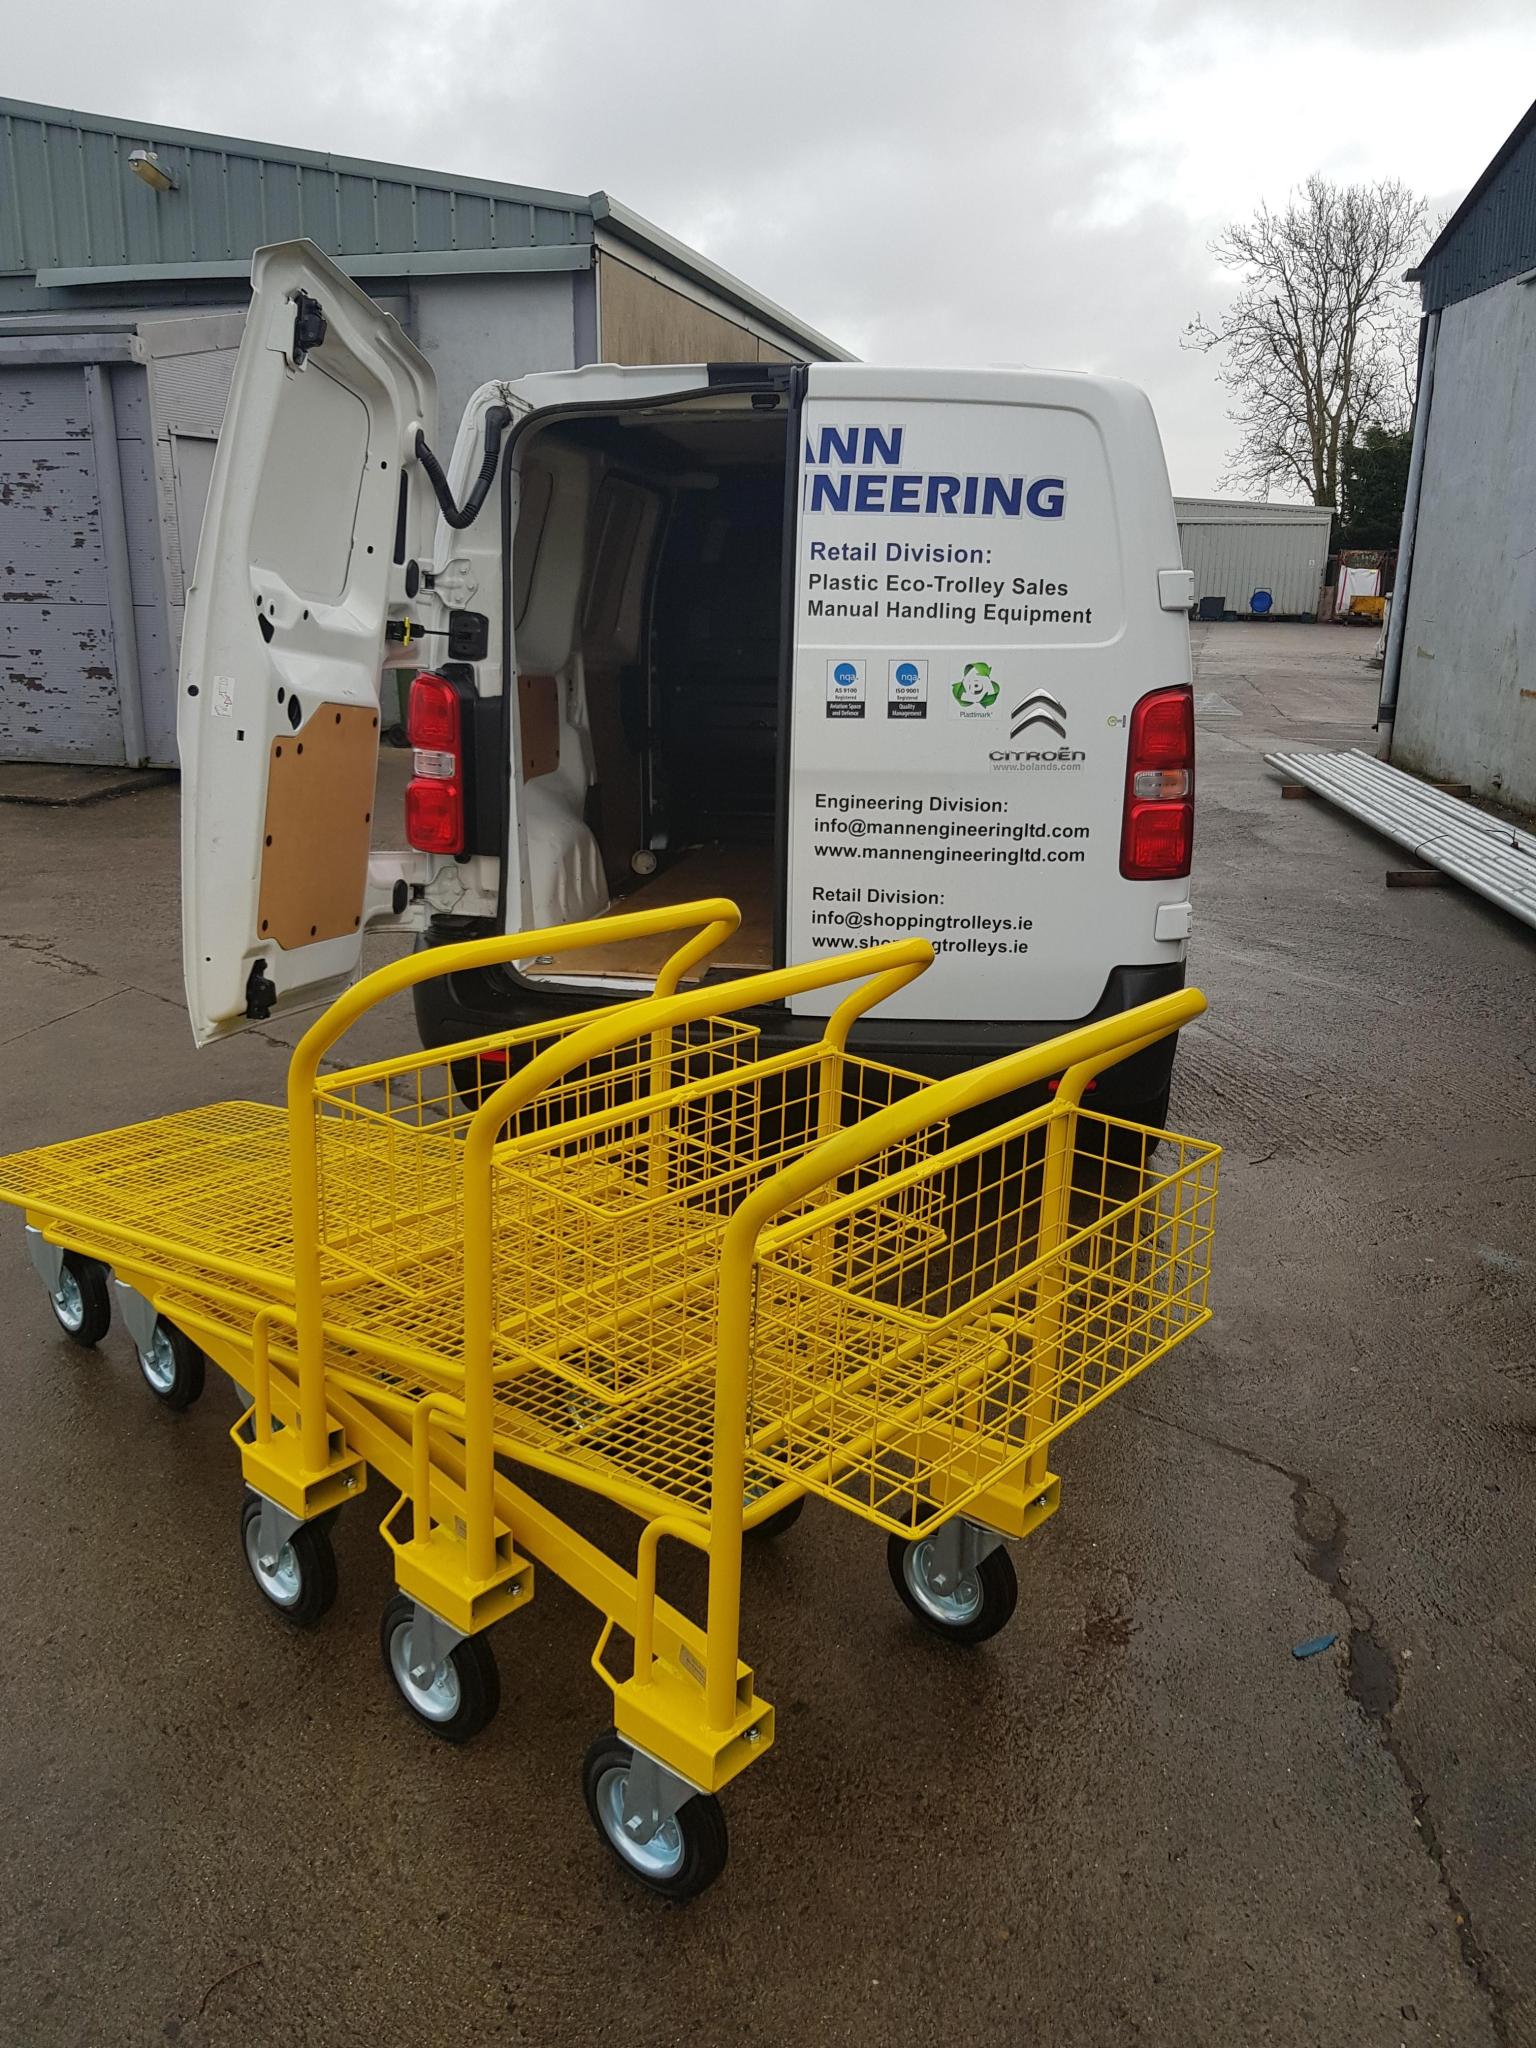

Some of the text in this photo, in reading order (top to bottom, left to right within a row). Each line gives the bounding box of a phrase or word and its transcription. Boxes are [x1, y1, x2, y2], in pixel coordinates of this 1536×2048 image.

[802, 473, 1065, 518] NEERING
[810, 541, 992, 564] Retail Division:
[808, 573, 1068, 599] Plastic Eco-Trolley Sales
[807, 600, 1092, 625] Manual Handling Equipment
[989, 747, 1086, 761] CITROËN
[993, 763, 1081, 771] www.bolands.com
[815, 794, 1008, 814] Engineering Division:
[814, 818, 1090, 840] info@mannengineeringltd.com
[814, 844, 1085, 865] www.mannengineeringltd.com
[812, 887, 945, 904] Retail Division:
[811, 910, 1033, 932] info@shoppingtrolleys.ie
